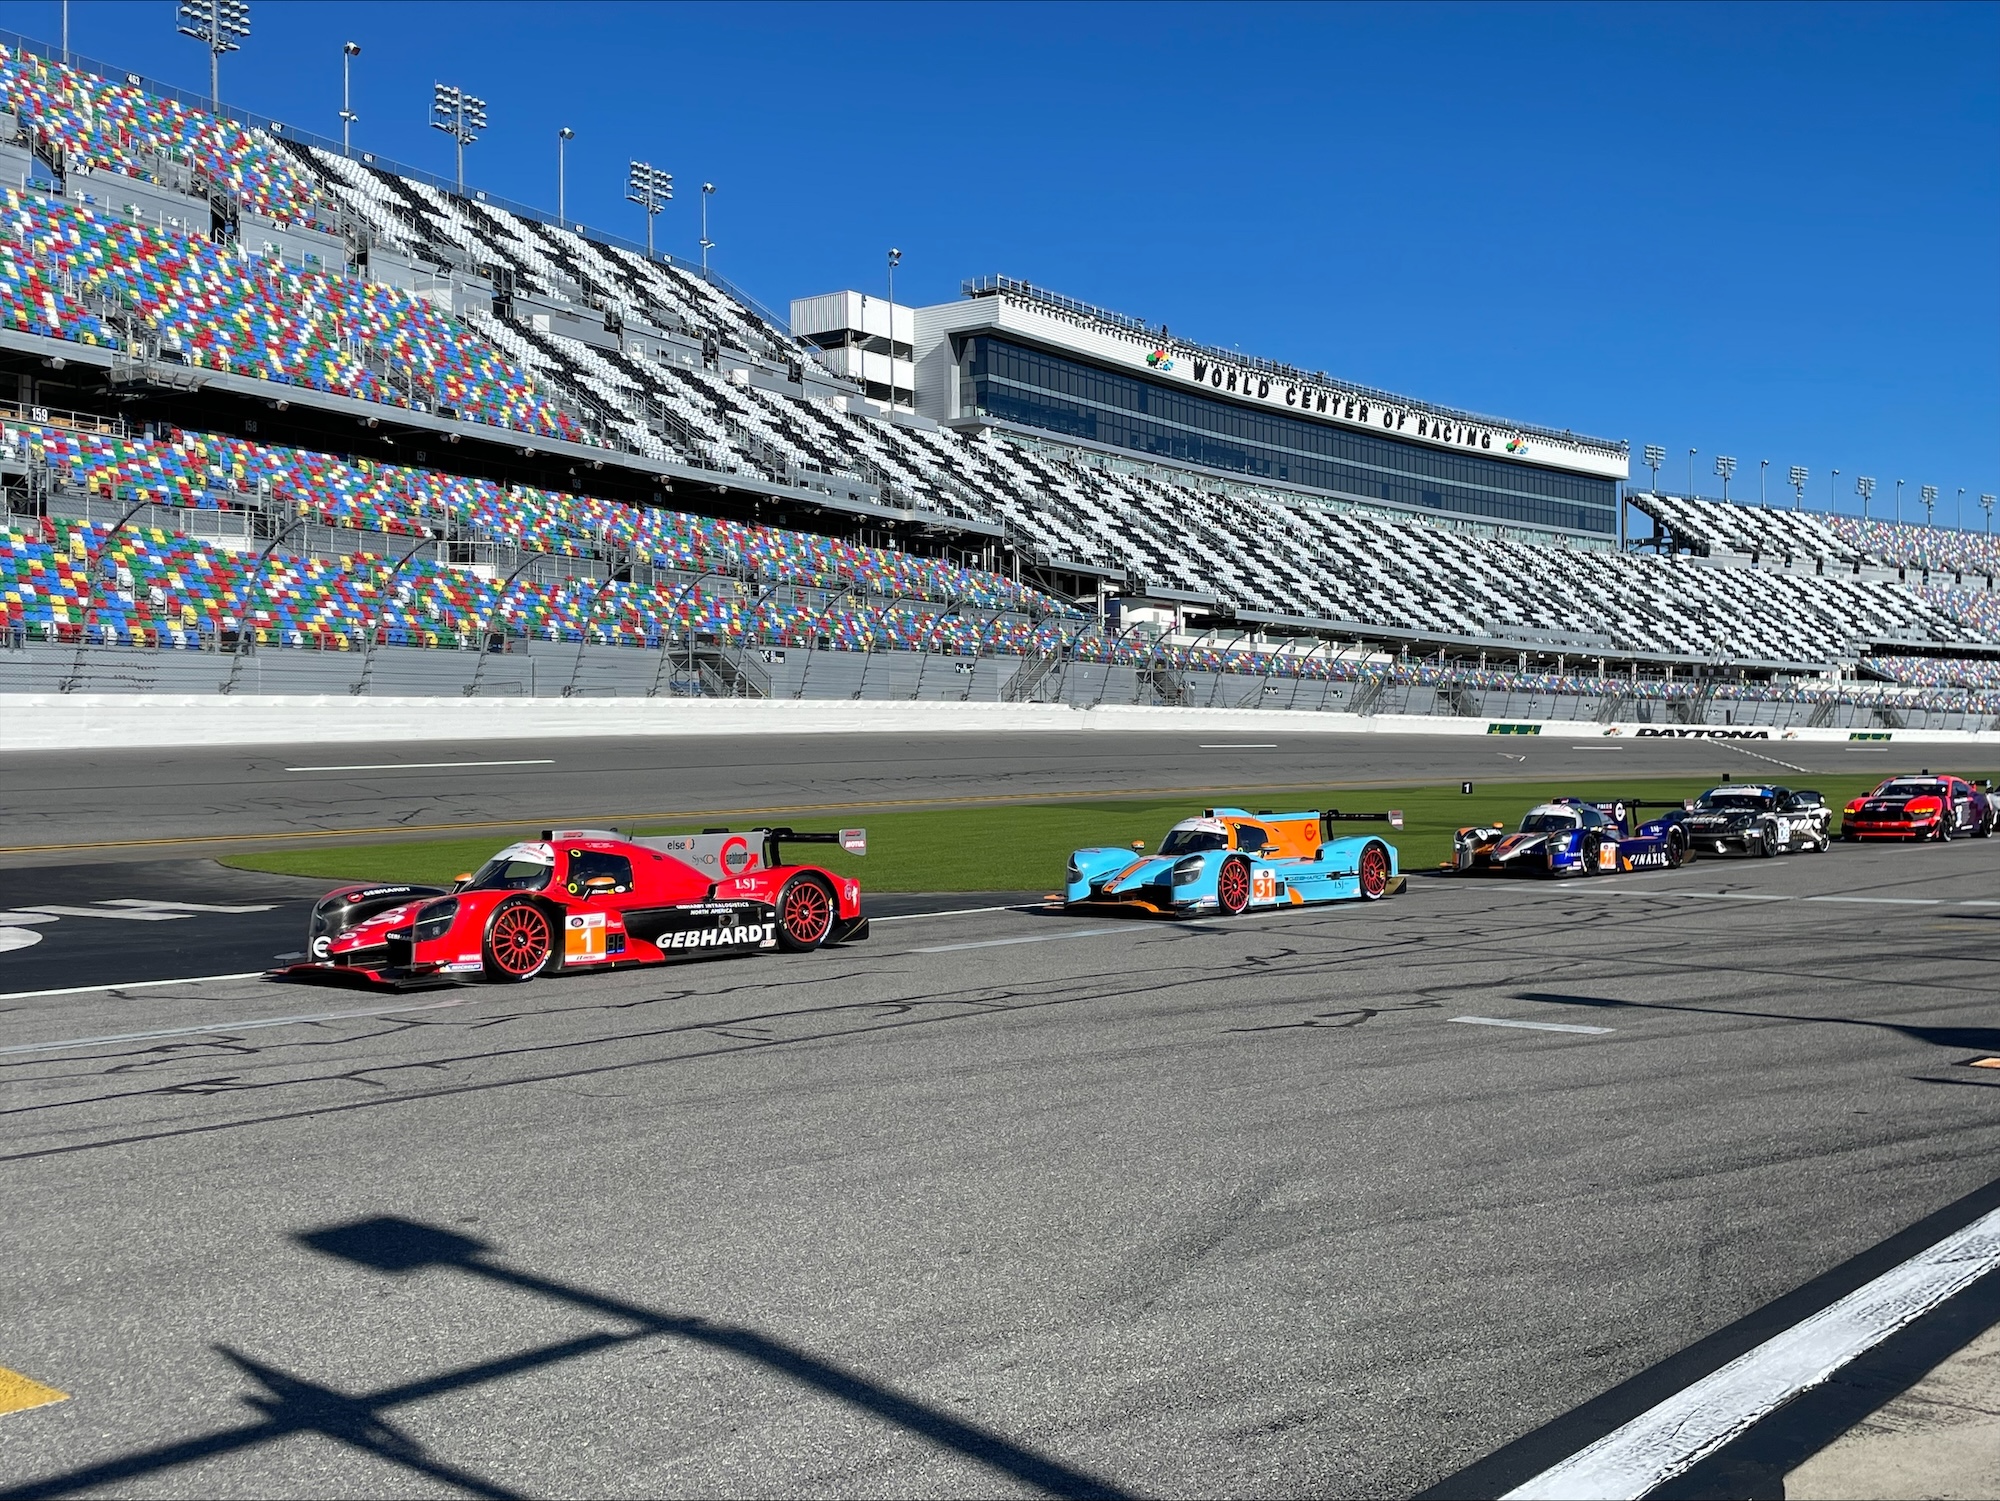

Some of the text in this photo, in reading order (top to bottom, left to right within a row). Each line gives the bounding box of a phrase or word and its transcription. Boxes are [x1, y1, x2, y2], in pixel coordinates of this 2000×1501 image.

[76, 163, 90, 176] 364
[1193, 359, 1491, 449] WORLD CENTER OF RACING
[32, 407, 48, 422] 159
[245, 420, 257, 432] 158
[1635, 728, 1769, 739] DAYTONA
[845, 840, 865, 848] MOTUL
[1629, 852, 1667, 866] PINAXIS
[363, 886, 411, 896] GEBHARDT
[735, 878, 756, 891] LSJ
[1255, 880, 1273, 898] 31
[581, 928, 592, 953] 1
[656, 923, 775, 949] GEBHARDT
